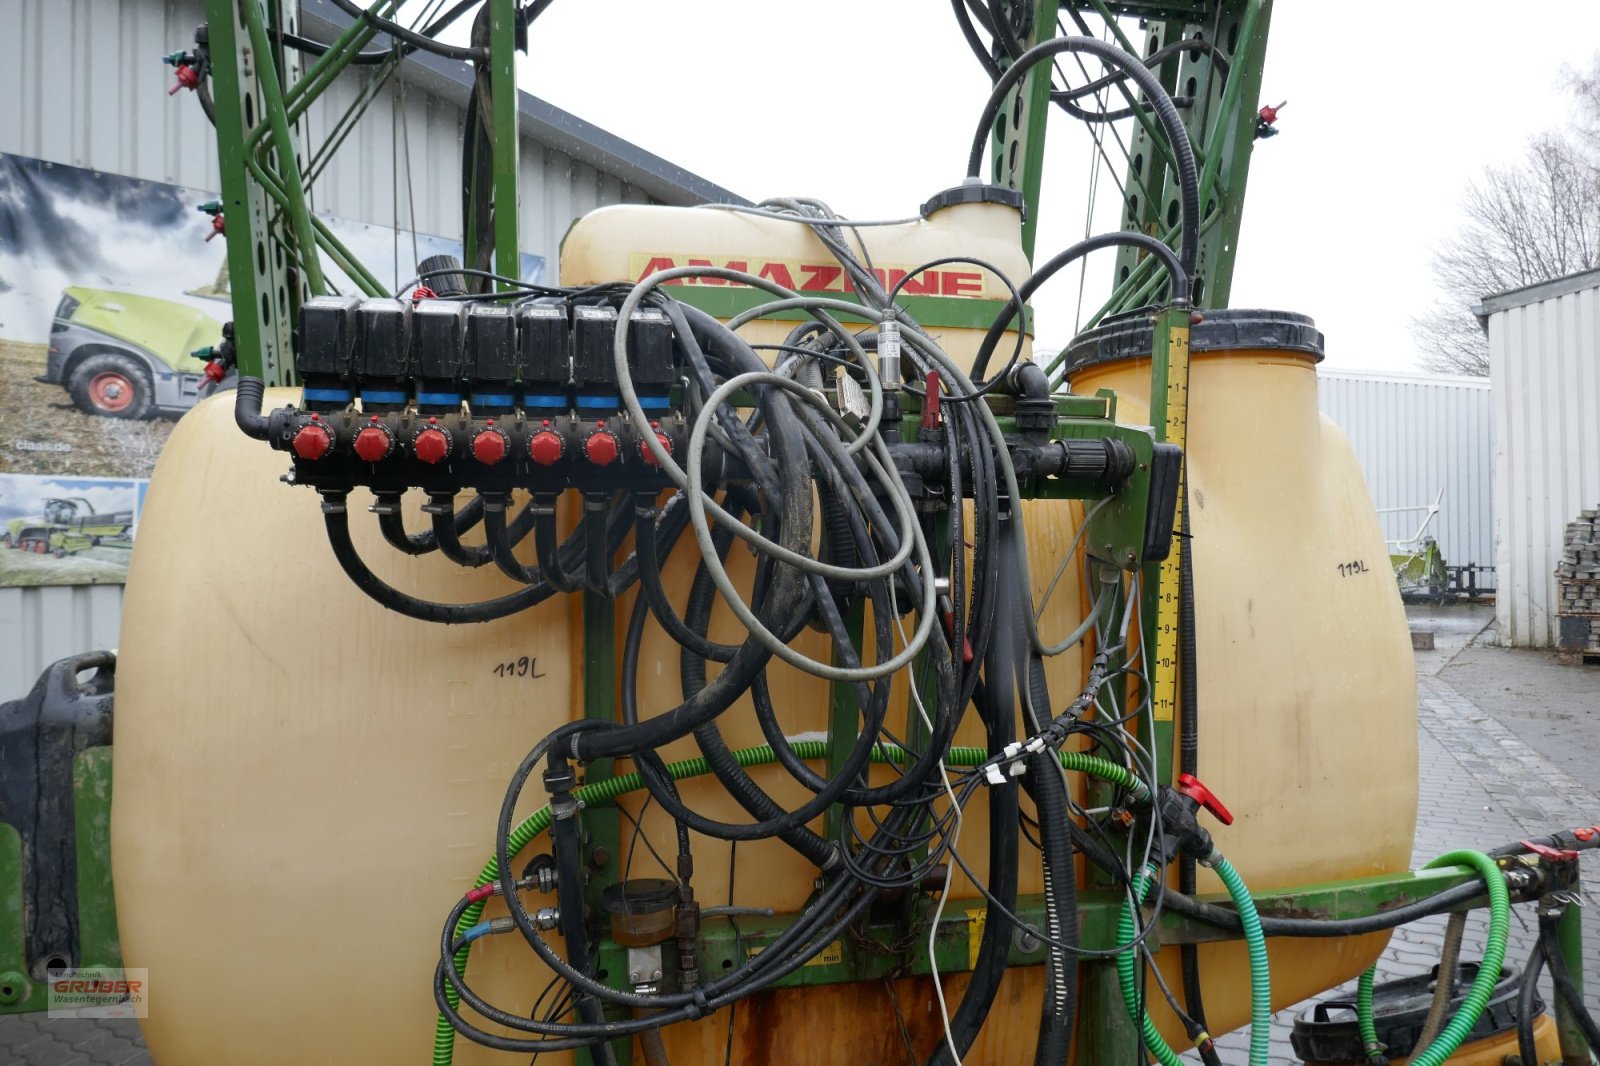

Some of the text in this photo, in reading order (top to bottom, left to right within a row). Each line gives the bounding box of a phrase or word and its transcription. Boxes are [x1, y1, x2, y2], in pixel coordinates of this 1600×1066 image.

[1176, 337, 1183, 348] 0
[1173, 416, 1179, 427] 2
[1167, 563, 1173, 574] 7
[1165, 592, 1171, 603] 8
[1164, 623, 1170, 634] 9
[492, 656, 546, 679] 119L
[1161, 657, 1170, 668] 10
[1160, 698, 1168, 709] 11
